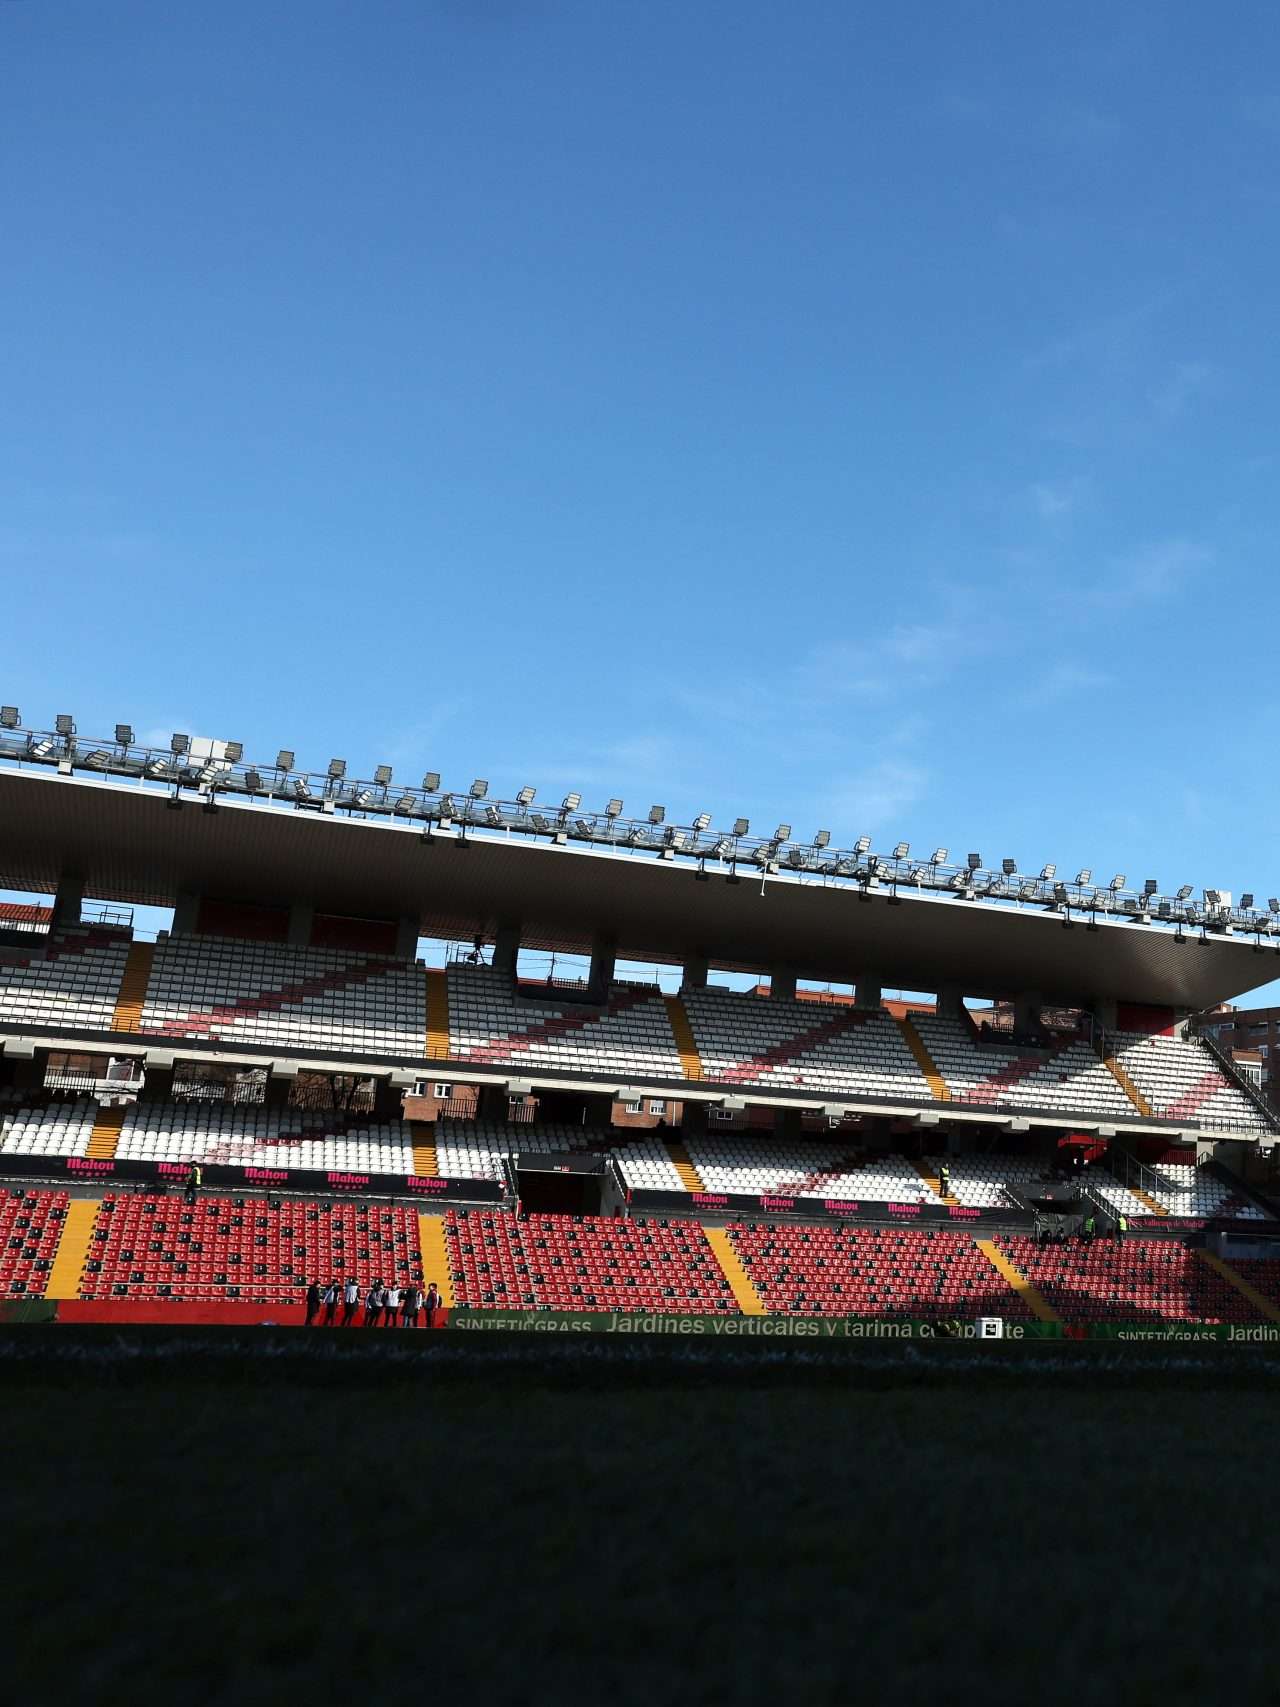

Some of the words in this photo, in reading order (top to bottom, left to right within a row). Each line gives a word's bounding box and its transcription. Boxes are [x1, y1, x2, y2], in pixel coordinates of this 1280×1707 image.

[66, 1157, 115, 1170] Mahou
[245, 1167, 289, 1180] Mahou
[327, 1171, 370, 1184] Mahou
[407, 1176, 448, 1188] Mahou
[456, 1318, 593, 1332] SINTETICGRASS
[606, 1313, 706, 1335] Jardines
[712, 1316, 820, 1337] verticales
[843, 1319, 913, 1338] tarima
